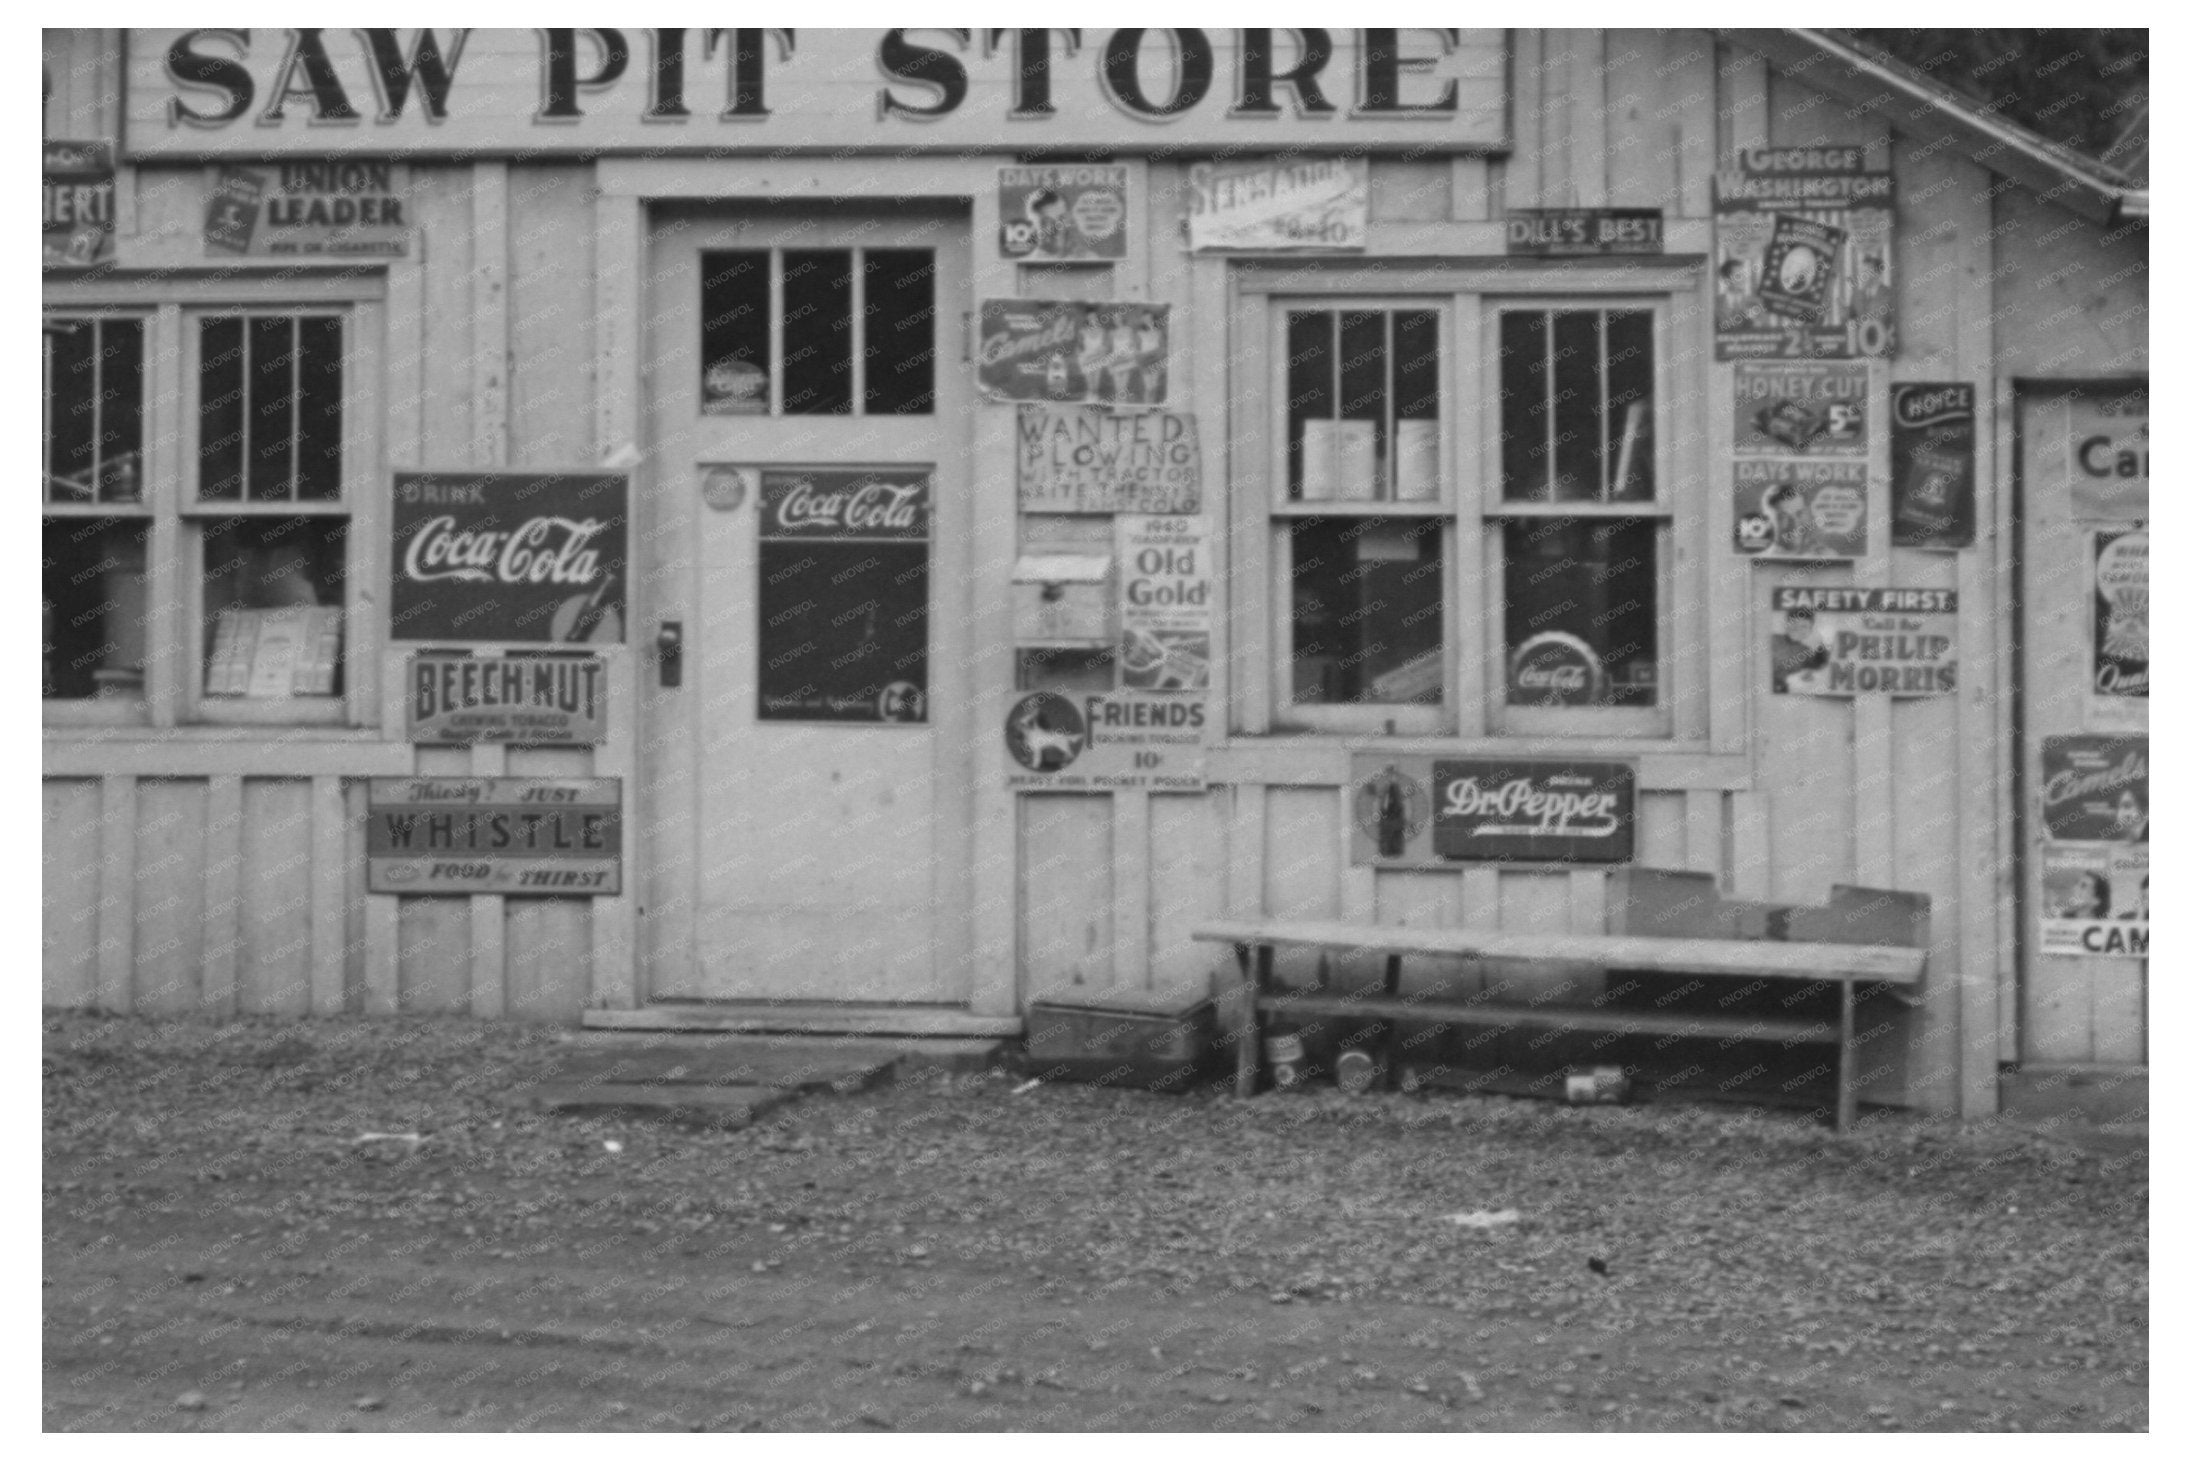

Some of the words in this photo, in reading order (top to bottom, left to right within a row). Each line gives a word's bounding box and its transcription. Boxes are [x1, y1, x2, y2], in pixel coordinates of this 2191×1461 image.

[165, 28, 474, 129] SAW
[532, 28, 795, 125] PIT
[875, 28, 1459, 123] STORE
[1746, 150, 1856, 171] GEORGE
[281, 164, 390, 193] UNION
[1058, 168, 1120, 187] WORK
[1715, 170, 1891, 199] WASHINGTON
[267, 198, 404, 226] LEADER
[1600, 219, 1659, 242] BEST
[1735, 377, 1814, 398] HONEY
[1822, 377, 1866, 398] CUT
[1017, 413, 1184, 443] WANTED
[1027, 443, 1191, 467] PLOWING
[1090, 465, 1197, 482] TRACTOR
[1797, 463, 1863, 480] WORK
[404, 484, 486, 504] DRINK
[777, 482, 922, 529] Coca-Cola
[404, 514, 608, 584] Coca-Cola
[1136, 548, 1195, 576] Old
[1127, 578, 1206, 607] Gold
[1781, 589, 1871, 609] SAFETY
[1882, 590, 1948, 609] FIRST
[1836, 630, 1950, 660] PHILIP
[1829, 660, 1958, 692] MORRIS
[1086, 696, 1205, 750] FRIENDS
[520, 787, 580, 802] JUST
[385, 813, 603, 848] WHISTLE
[429, 862, 492, 879] FOOD
[518, 870, 609, 886] THIRST
